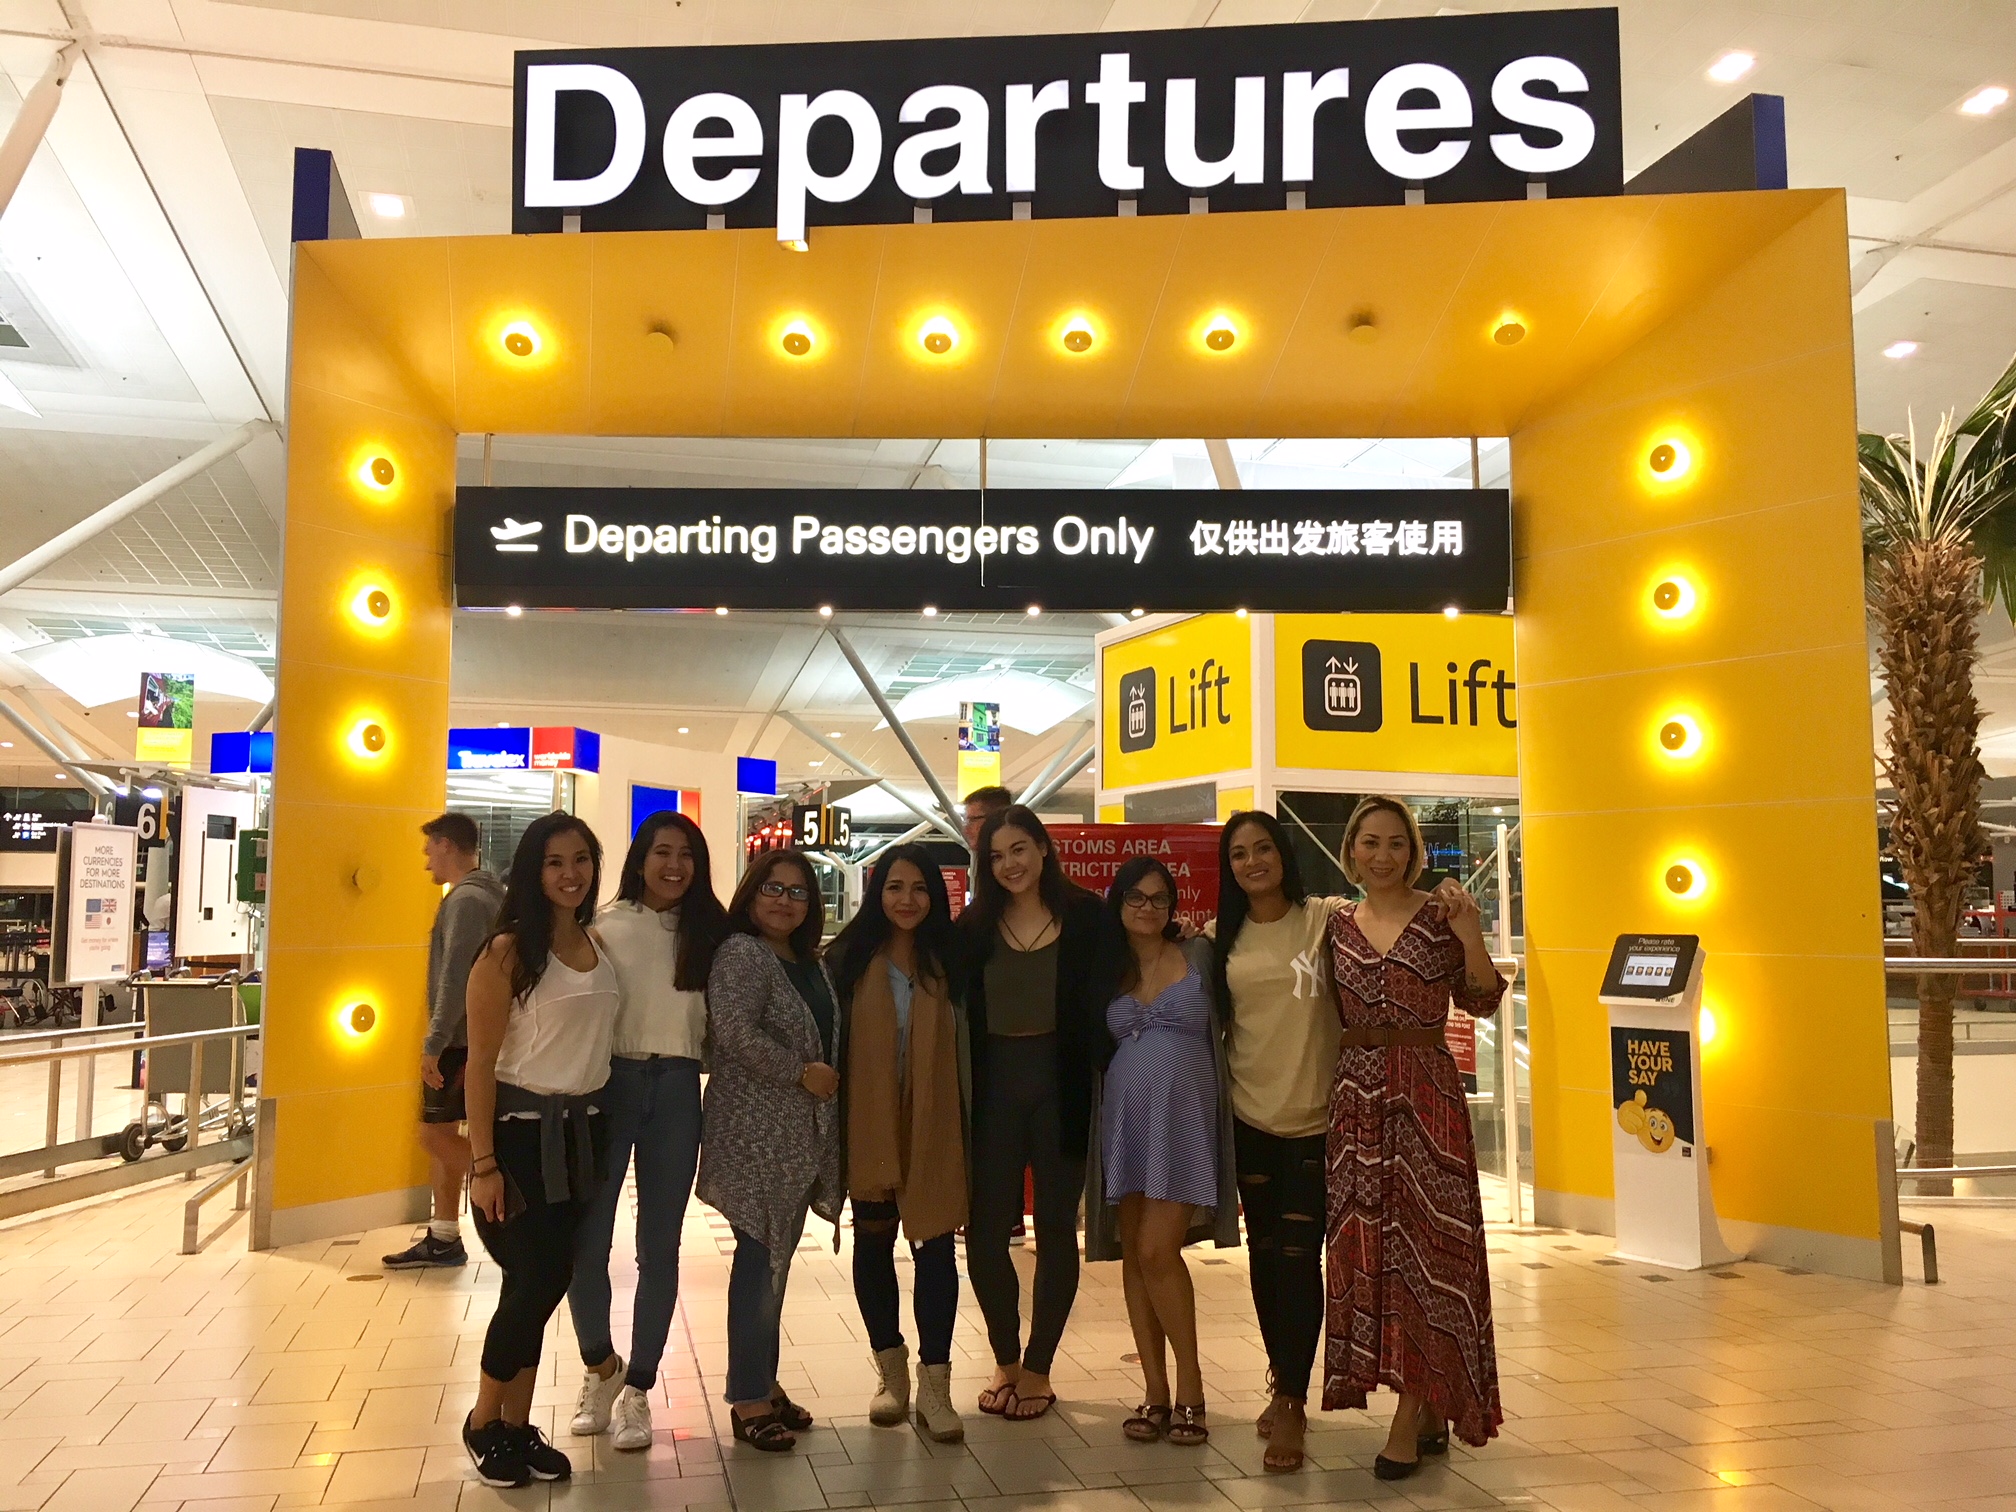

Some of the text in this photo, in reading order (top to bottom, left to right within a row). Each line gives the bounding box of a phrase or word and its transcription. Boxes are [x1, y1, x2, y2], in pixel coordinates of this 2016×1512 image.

[524, 52, 1596, 246] Departures
[565, 514, 1154, 563] Departing Passengers Only
[1190, 520, 1464, 556] 仅供出发旅客使用
[1170, 658, 1231, 734] Lift
[1410, 659, 1517, 728] Lift
[137, 803, 155, 839] 6
[804, 811, 818, 845] 5
[840, 812, 849, 846] 5
[95, 846, 113, 855] MORE
[1052, 839, 1171, 855] STOMS AREA
[83, 856, 123, 867] CURRENCIES
[1167, 862, 1191, 877] EA
[86, 868, 120, 878] FOR MORE
[80, 879, 125, 889] DESTINATIONS
[1177, 885, 1201, 903] nly
[1638, 937, 1660, 945] Please
[1644, 945, 1681, 953] experience
[1627, 1039, 1671, 1056] HAVE
[1627, 1054, 1673, 1072] YOUR
[1628, 1069, 1658, 1086] SAY
